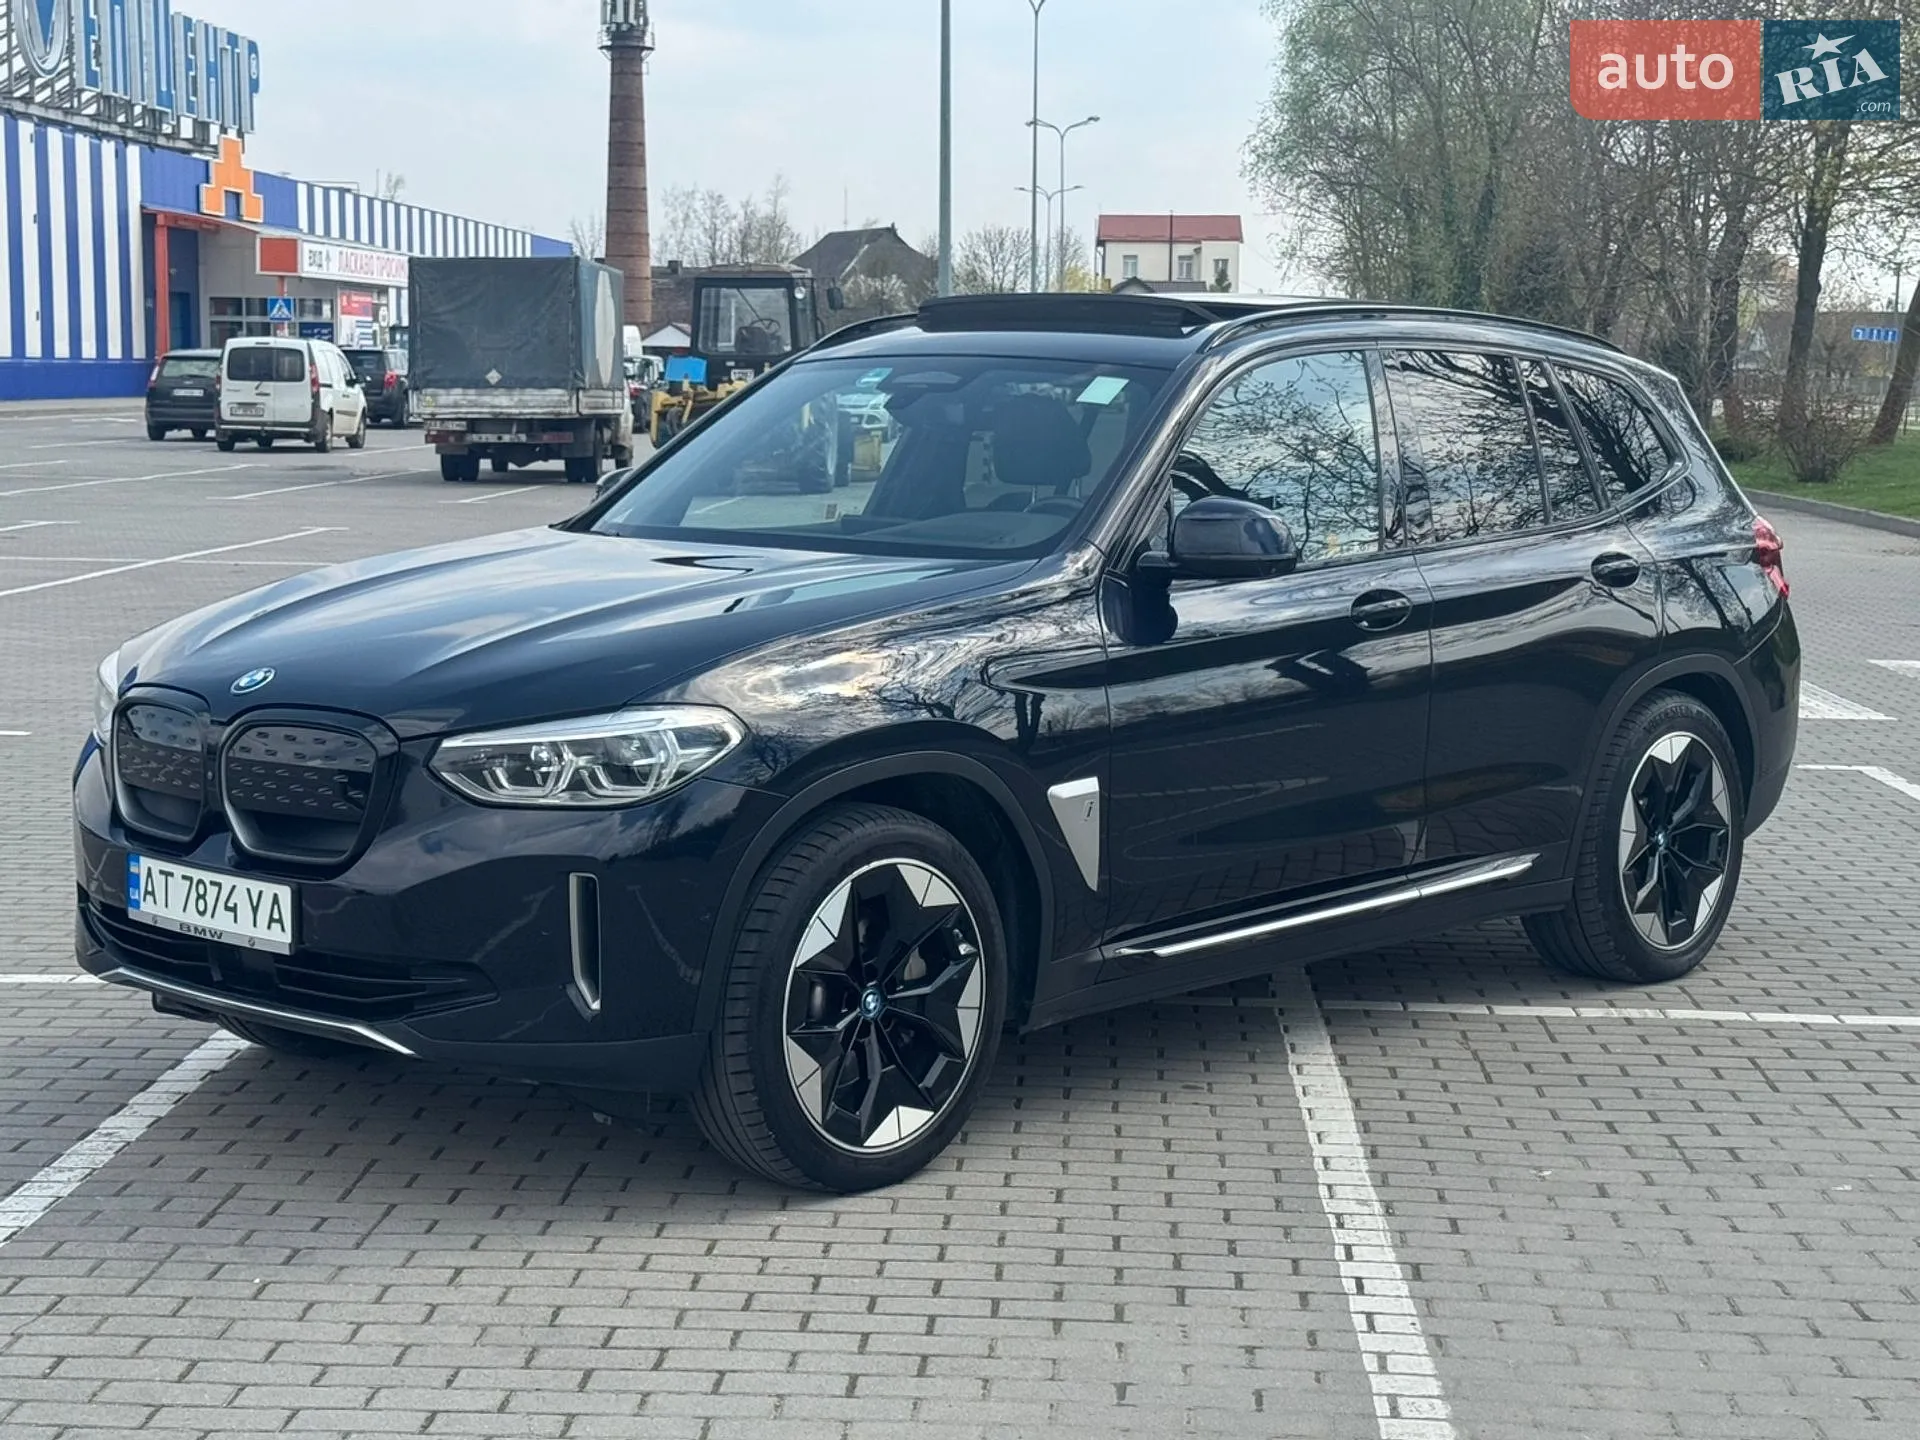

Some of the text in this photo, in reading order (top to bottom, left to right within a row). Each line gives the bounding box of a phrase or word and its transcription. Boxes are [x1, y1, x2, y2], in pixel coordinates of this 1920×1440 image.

[143, 866, 285, 933] AT 7874 YA
[179, 923, 223, 940] BMW
